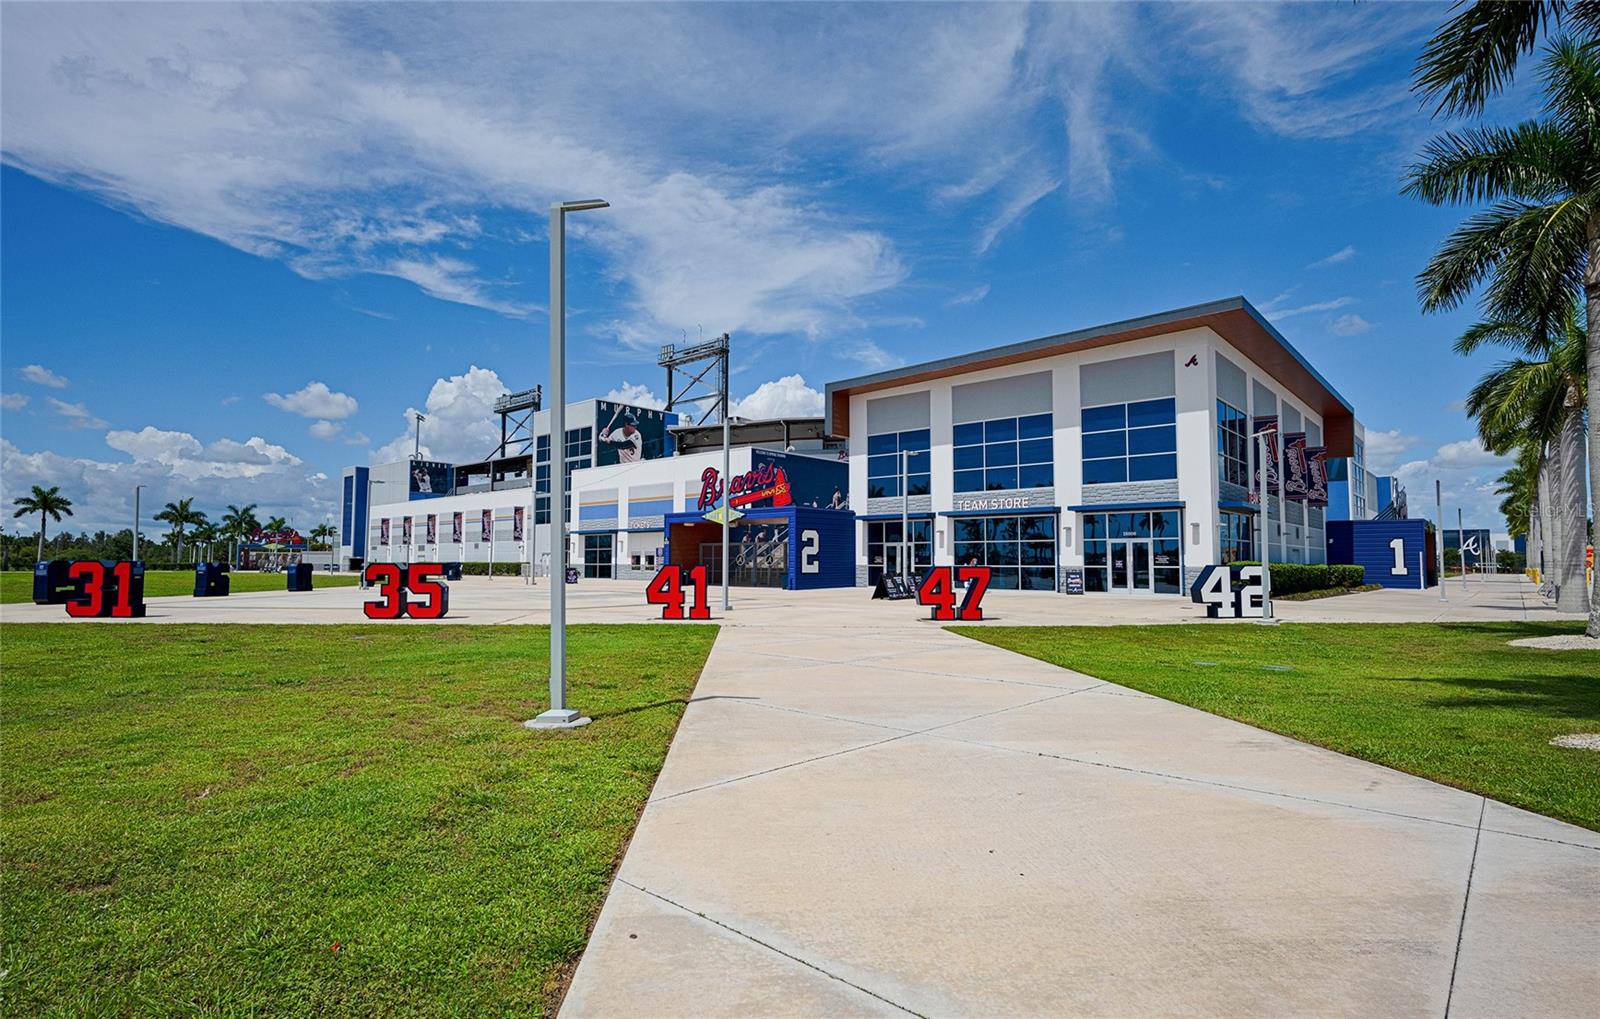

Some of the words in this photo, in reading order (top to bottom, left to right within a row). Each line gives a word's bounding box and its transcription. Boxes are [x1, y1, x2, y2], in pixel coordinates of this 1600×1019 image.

[600, 402, 664, 421] MURPHY
[959, 500, 988, 511] TEAM
[991, 497, 1029, 509] STORE
[801, 529, 819, 574] 2
[1390, 538, 1408, 575] 1
[66, 560, 134, 618] 31
[364, 563, 444, 619] 35
[646, 565, 711, 620] 41
[919, 566, 992, 621] 47
[1200, 565, 1272, 618] 42
